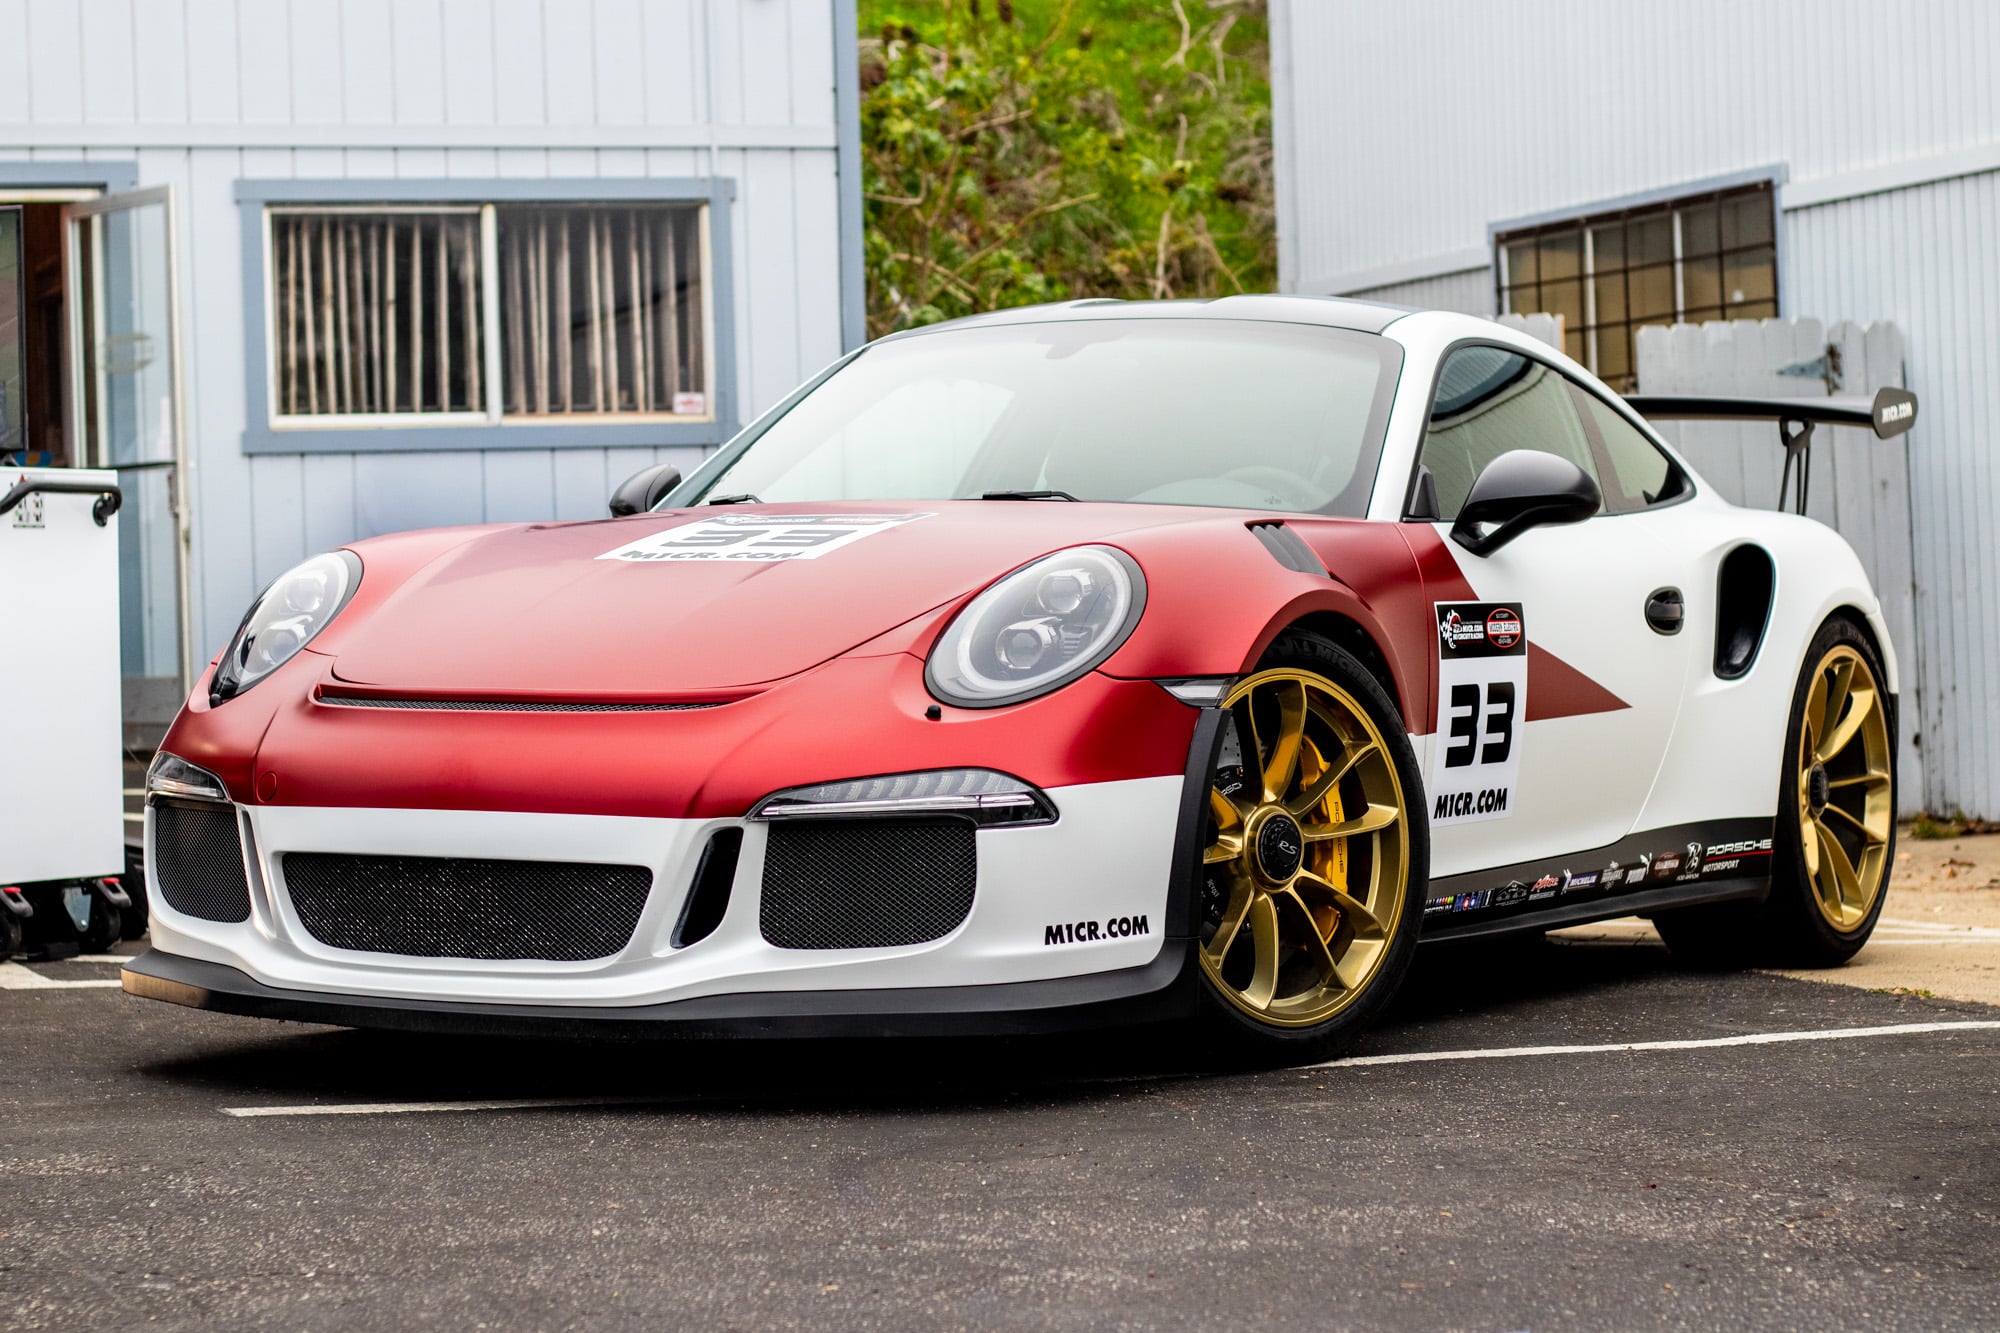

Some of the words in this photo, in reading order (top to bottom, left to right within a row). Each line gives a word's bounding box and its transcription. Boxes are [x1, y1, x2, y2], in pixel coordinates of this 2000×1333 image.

[660, 530, 858, 547] 33
[1445, 681, 1515, 768] 33
[1334, 801, 1345, 873] POCHE
[1706, 838, 1773, 856] PORSCHE
[1702, 859, 1740, 873] MOTORSPORT
